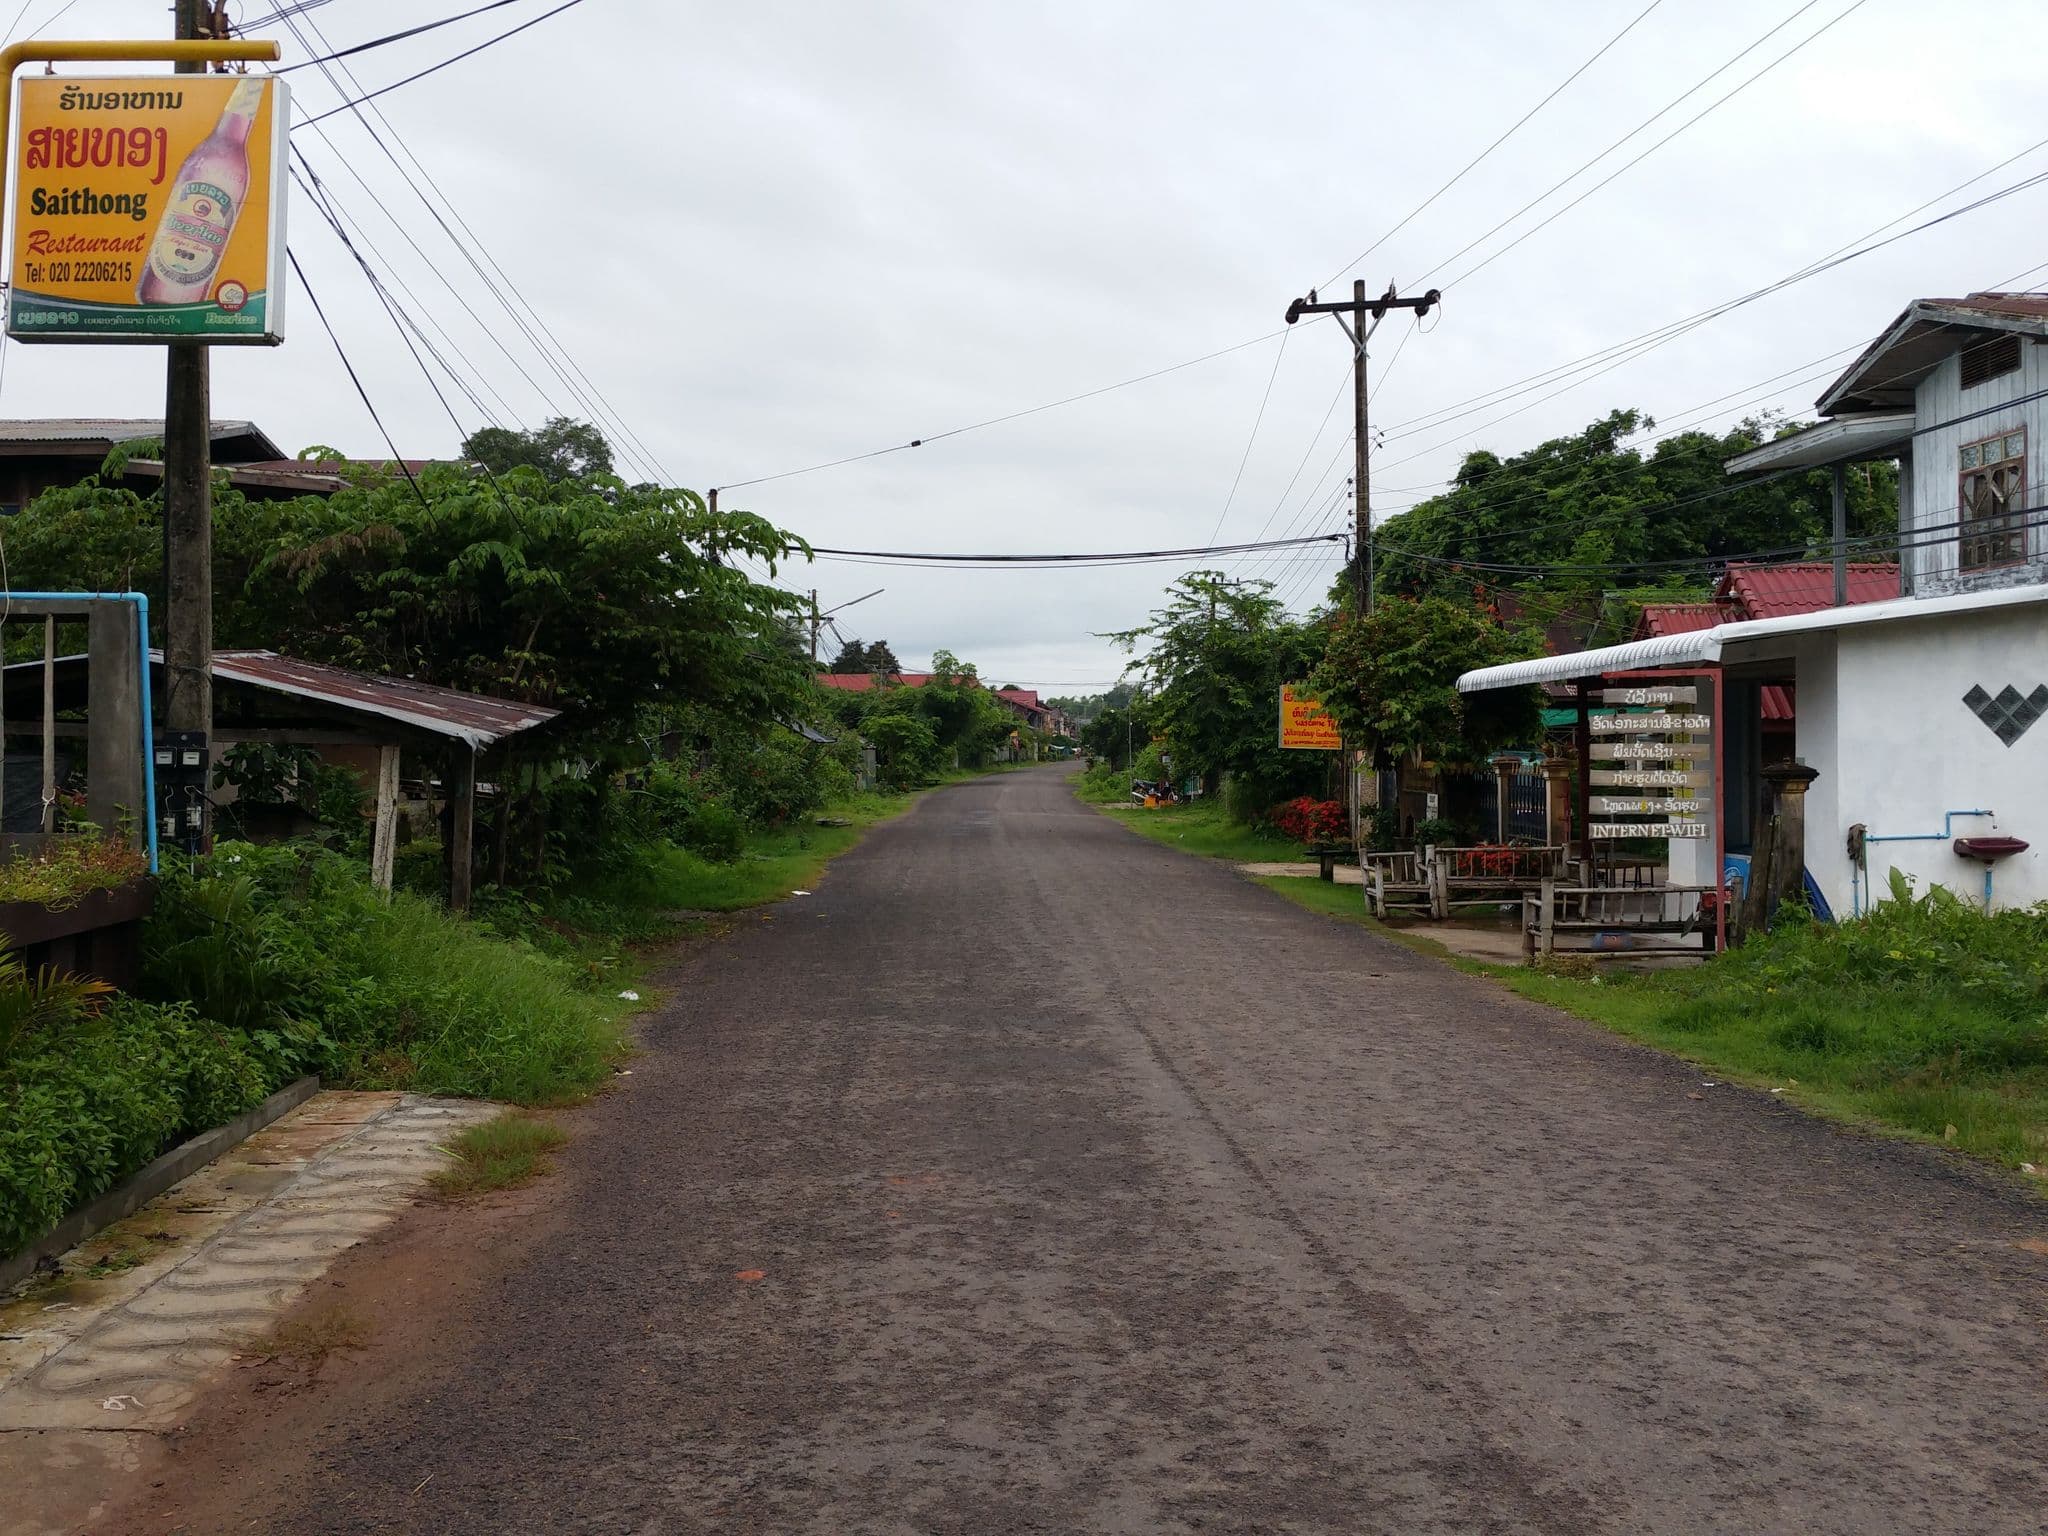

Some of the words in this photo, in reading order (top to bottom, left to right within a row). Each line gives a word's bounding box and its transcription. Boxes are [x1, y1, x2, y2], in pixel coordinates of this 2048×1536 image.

[59, 85, 183, 110] ຮ້ານອາຫານ
[26, 126, 168, 185] ສາຍທອງ
[30, 187, 148, 221] Saithong
[26, 229, 146, 256] Restaurant
[25, 262, 45, 283] Tel:
[49, 262, 70, 282] 020
[74, 262, 132, 282] 22206215
[1592, 823, 1707, 838] INTERNET-WIFI
